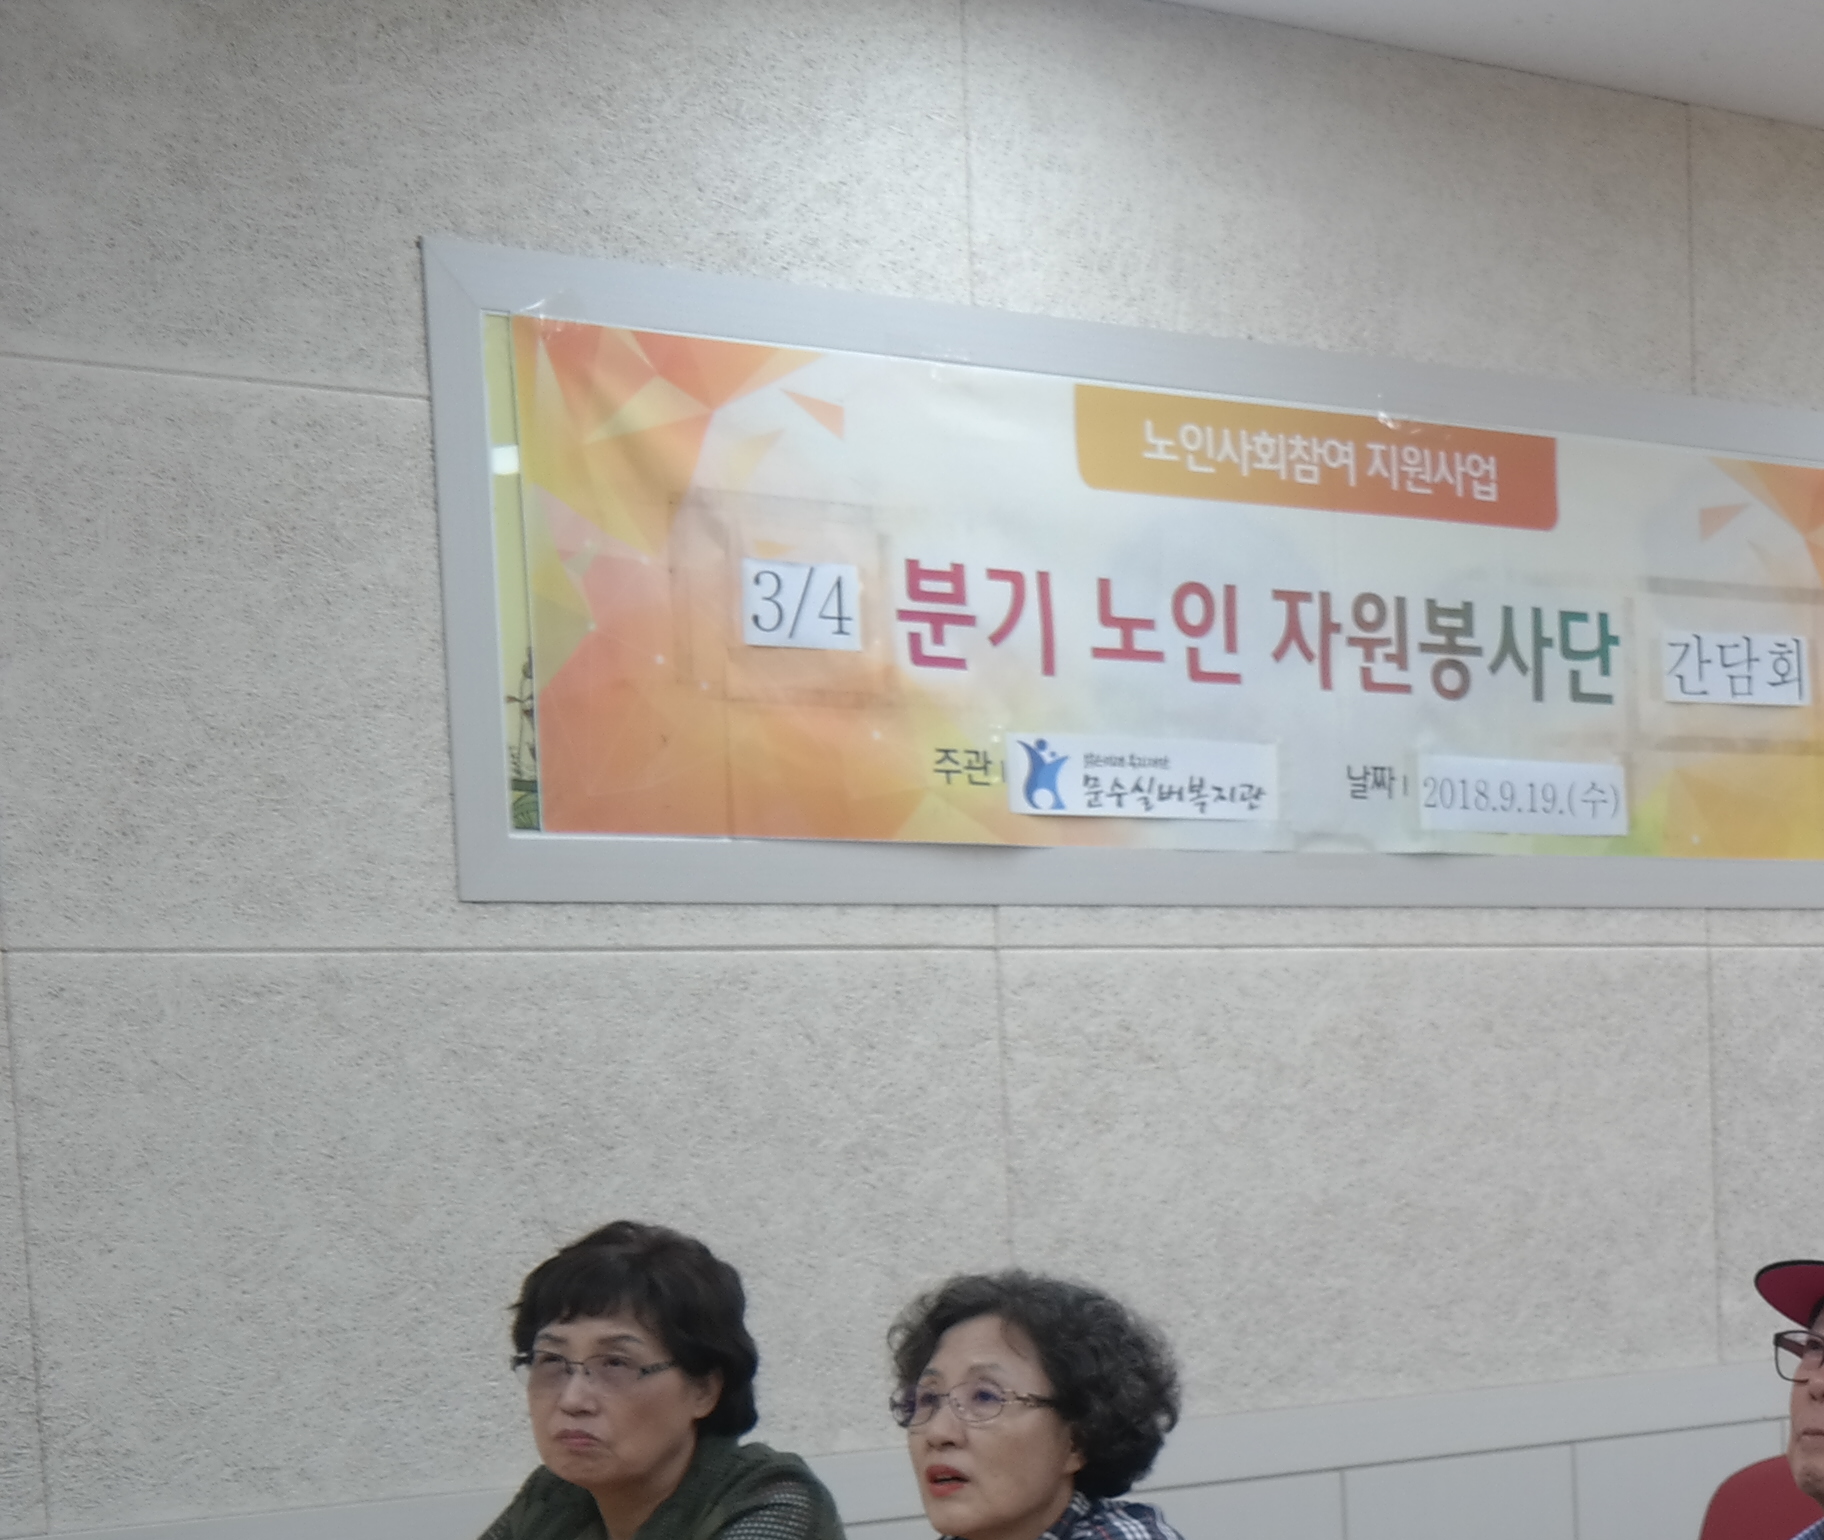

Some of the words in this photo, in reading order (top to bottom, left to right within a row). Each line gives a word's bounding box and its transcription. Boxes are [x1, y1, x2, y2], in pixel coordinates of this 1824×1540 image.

[1142, 419, 1357, 487] 노인사회참여
[1366, 441, 1499, 503] 지원사업
[751, 566, 854, 639] 3/4
[896, 558, 1057, 677] 분기
[1091, 577, 1243, 685] 노인
[1270, 588, 1620, 704] 자원봉사단
[1666, 633, 1806, 701] 간담회
[932, 747, 992, 787] 주관
[1346, 764, 1397, 800] 날짜
[1082, 774, 1267, 814] 문수실버복지관
